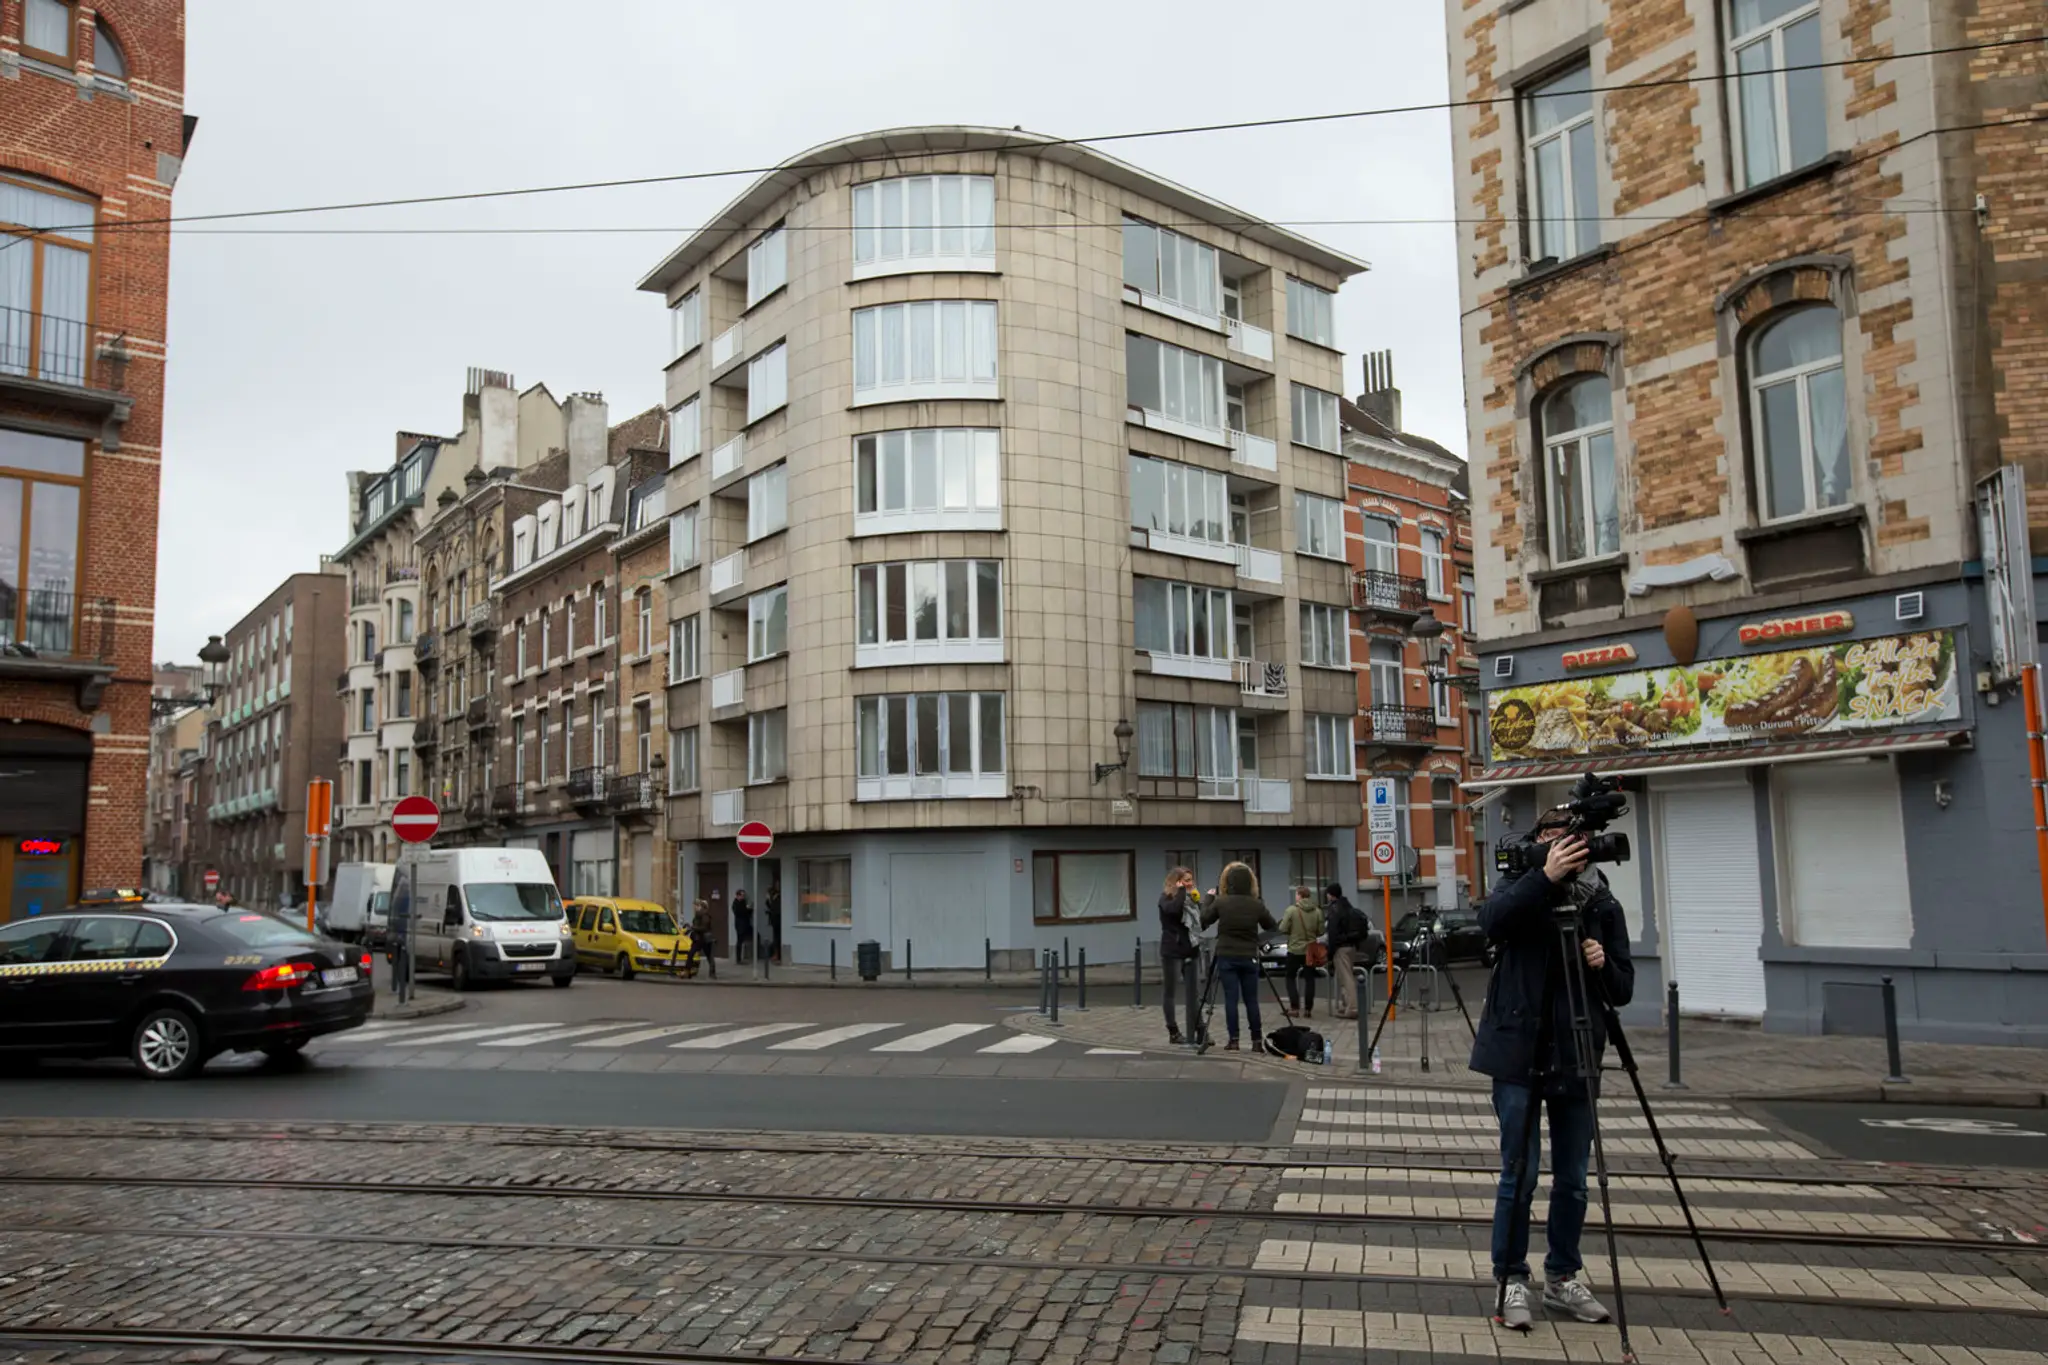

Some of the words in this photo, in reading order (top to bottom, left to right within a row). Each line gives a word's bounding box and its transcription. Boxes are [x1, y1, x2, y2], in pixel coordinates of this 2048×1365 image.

[1739, 614, 1844, 642] DÖNER
[1561, 646, 1628, 668] PIZZA
[1845, 637, 1940, 668] Grillade
[1862, 659, 1937, 697] Tayba
[1848, 686, 1945, 719] SNACK
[1377, 789, 1384, 799] P
[1378, 848, 1390, 858] 30
